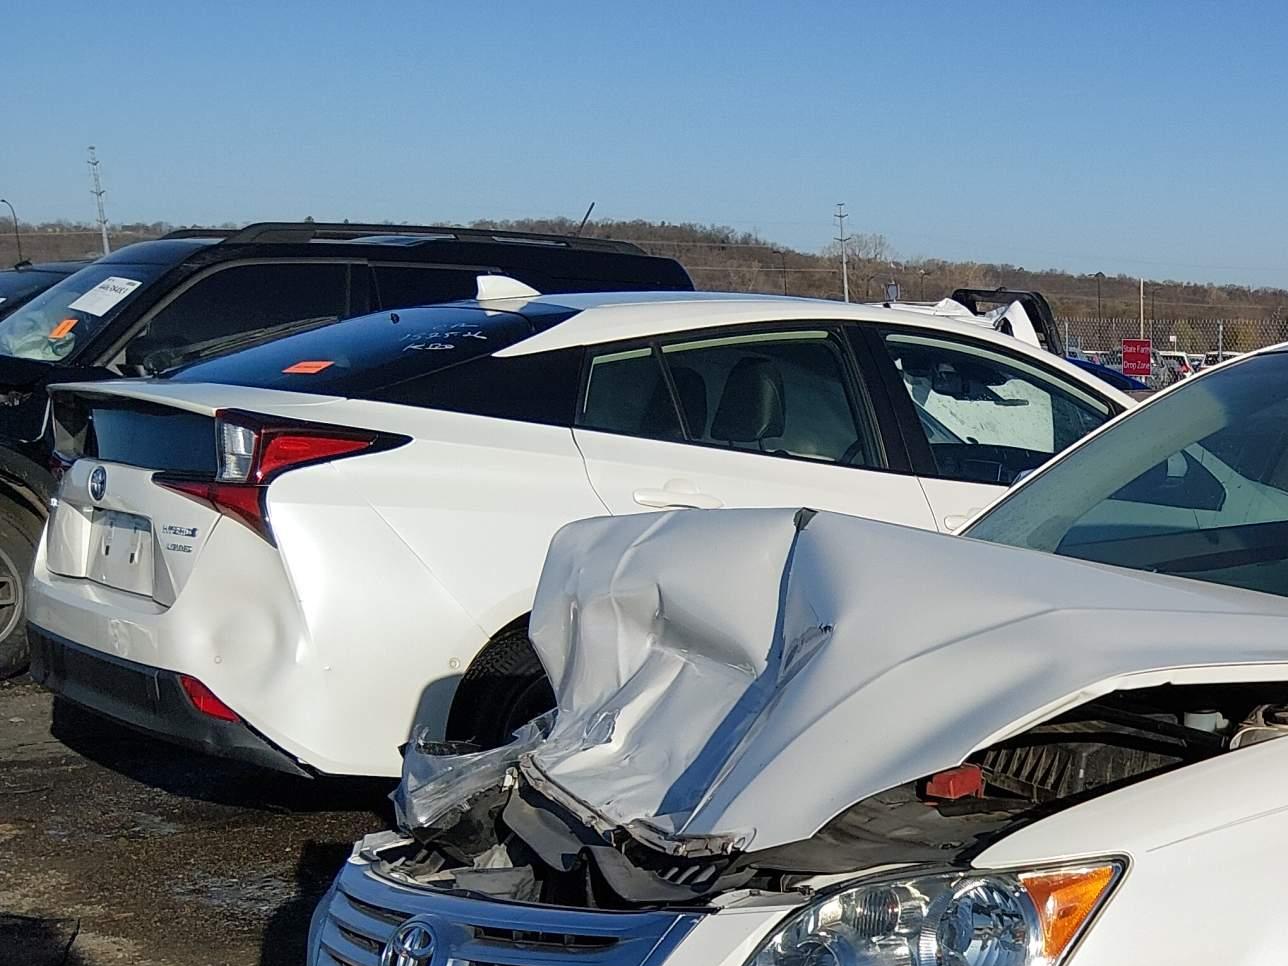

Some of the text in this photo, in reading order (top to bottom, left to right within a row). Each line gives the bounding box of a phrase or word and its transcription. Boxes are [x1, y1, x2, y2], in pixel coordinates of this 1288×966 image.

[1123, 345, 1150, 353] State Farm
[1123, 361, 1150, 370] Drop Zone
